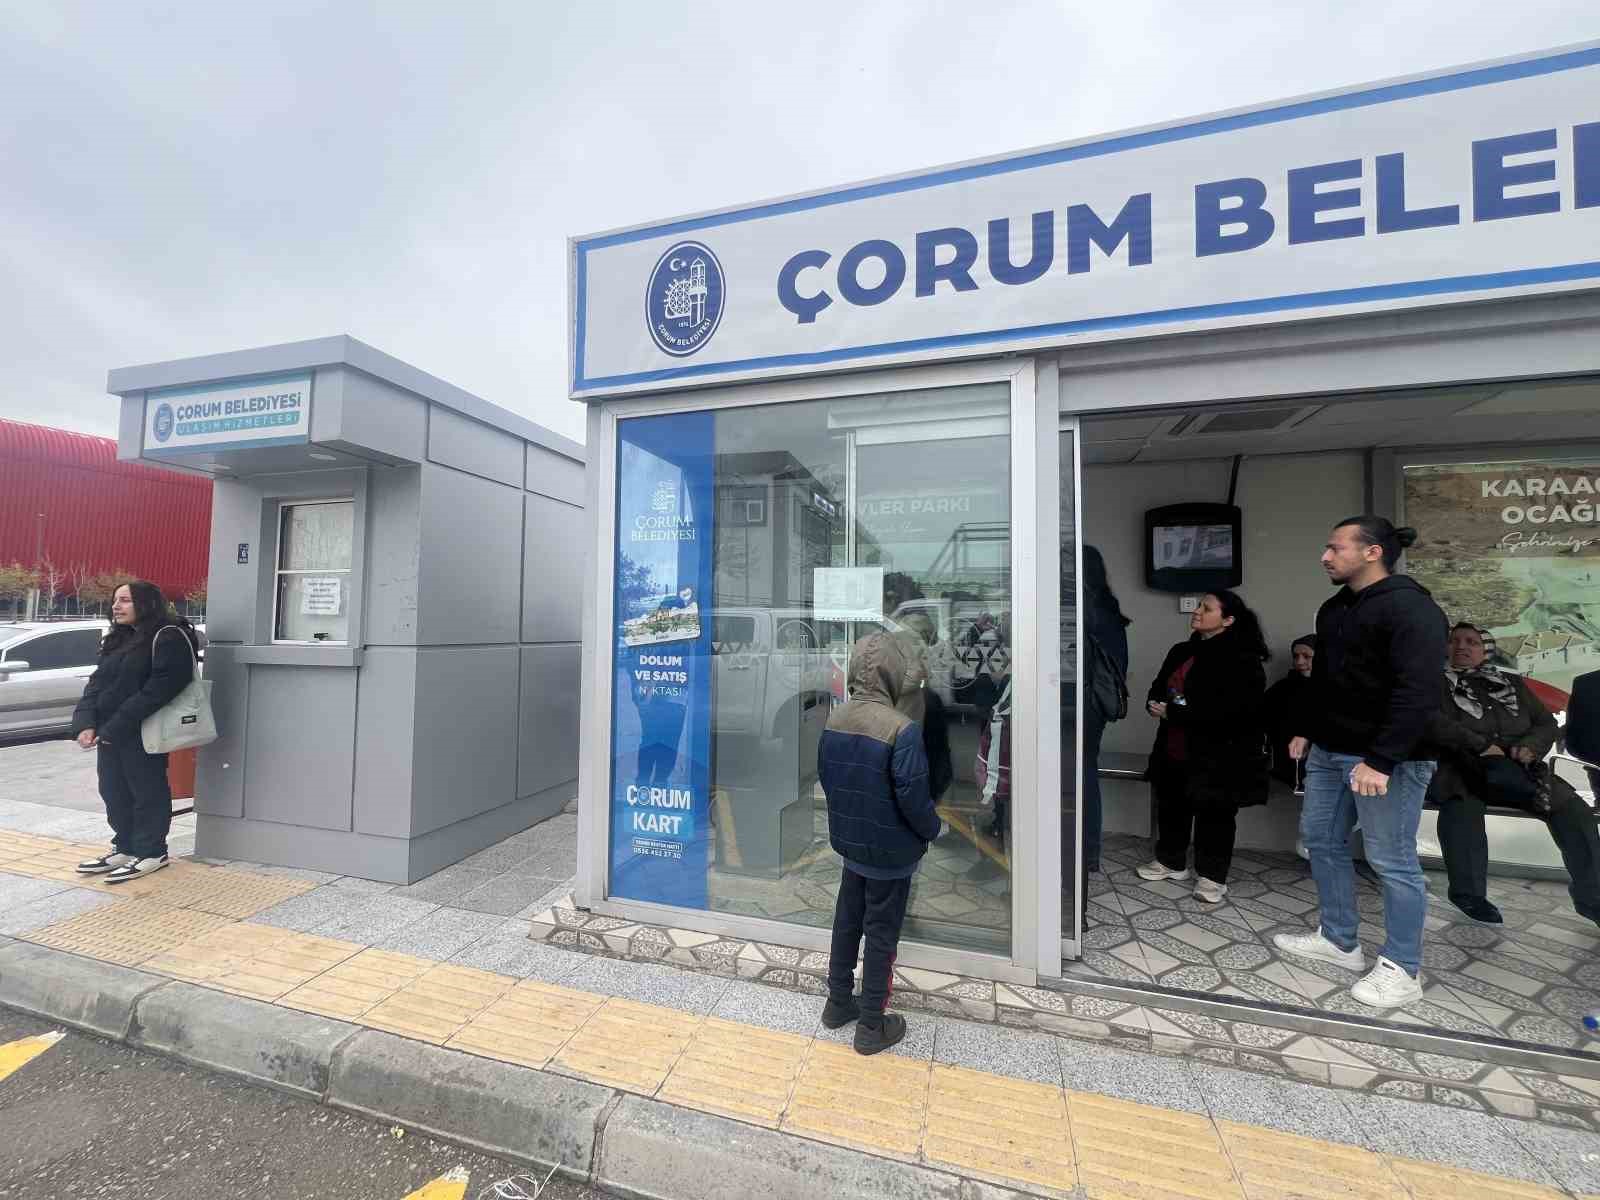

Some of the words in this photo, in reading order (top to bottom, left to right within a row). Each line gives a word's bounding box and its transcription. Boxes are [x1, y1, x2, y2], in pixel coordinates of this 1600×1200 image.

[777, 192, 1153, 324] ÇORUM
[177, 401, 222, 421] ÇORUM
[224, 392, 302, 415] BELEDİYESİ
[635, 515, 691, 530] ÇORUM
[640, 655, 682, 666] DOLUM
[635, 670, 651, 681] VE
[653, 671, 688, 684] SATIŞ
[640, 686, 682, 697] NKTASI
[627, 785, 691, 809] ÇORUM
[633, 812, 682, 834] KART
